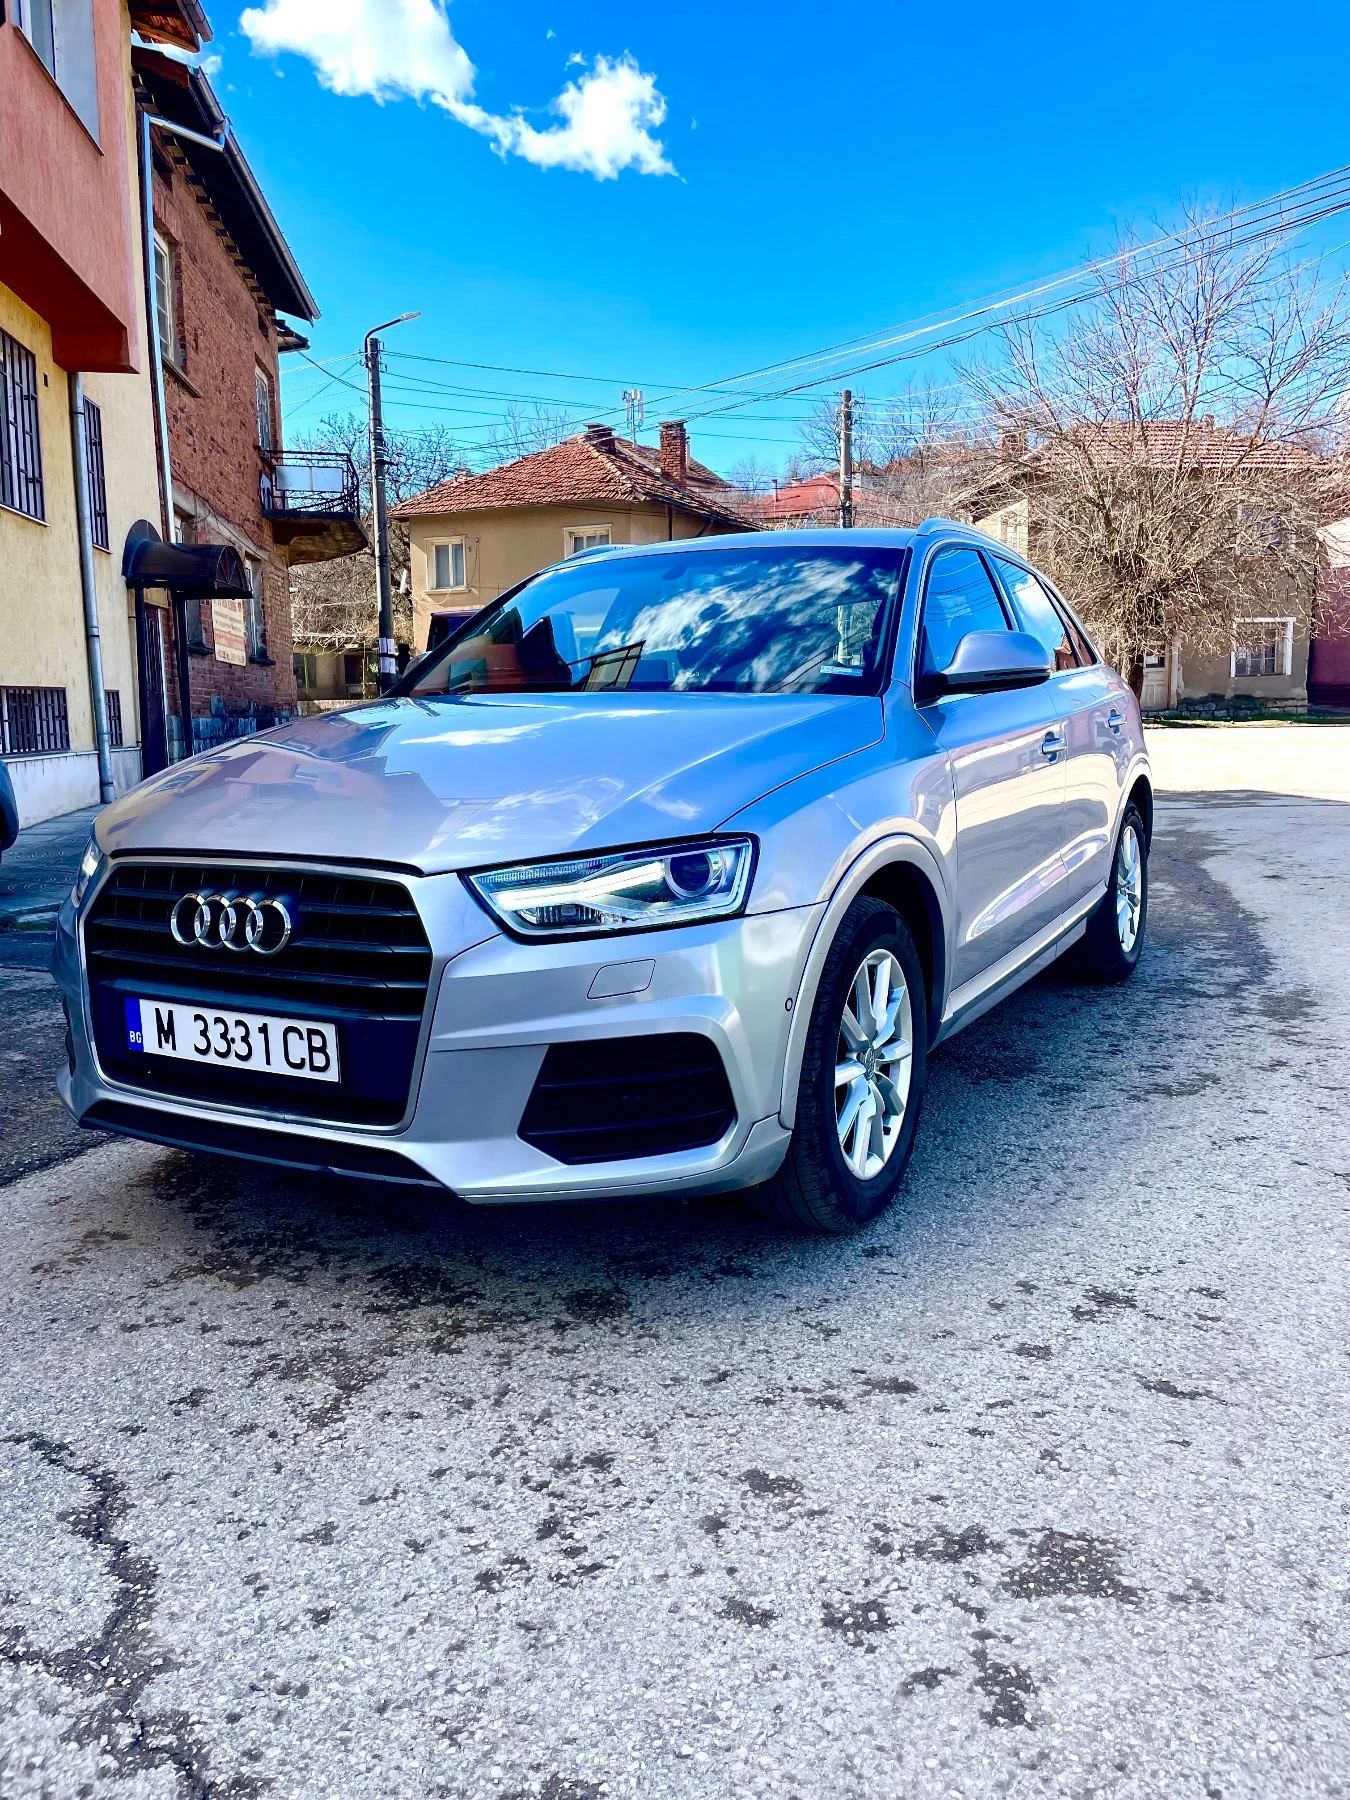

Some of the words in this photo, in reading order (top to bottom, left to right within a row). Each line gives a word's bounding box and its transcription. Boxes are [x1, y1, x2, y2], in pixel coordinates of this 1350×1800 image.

[129, 1030, 142, 1044] BG
[155, 1007, 177, 1051] M
[193, 1013, 272, 1066] 3331
[282, 1025, 331, 1073] CB
